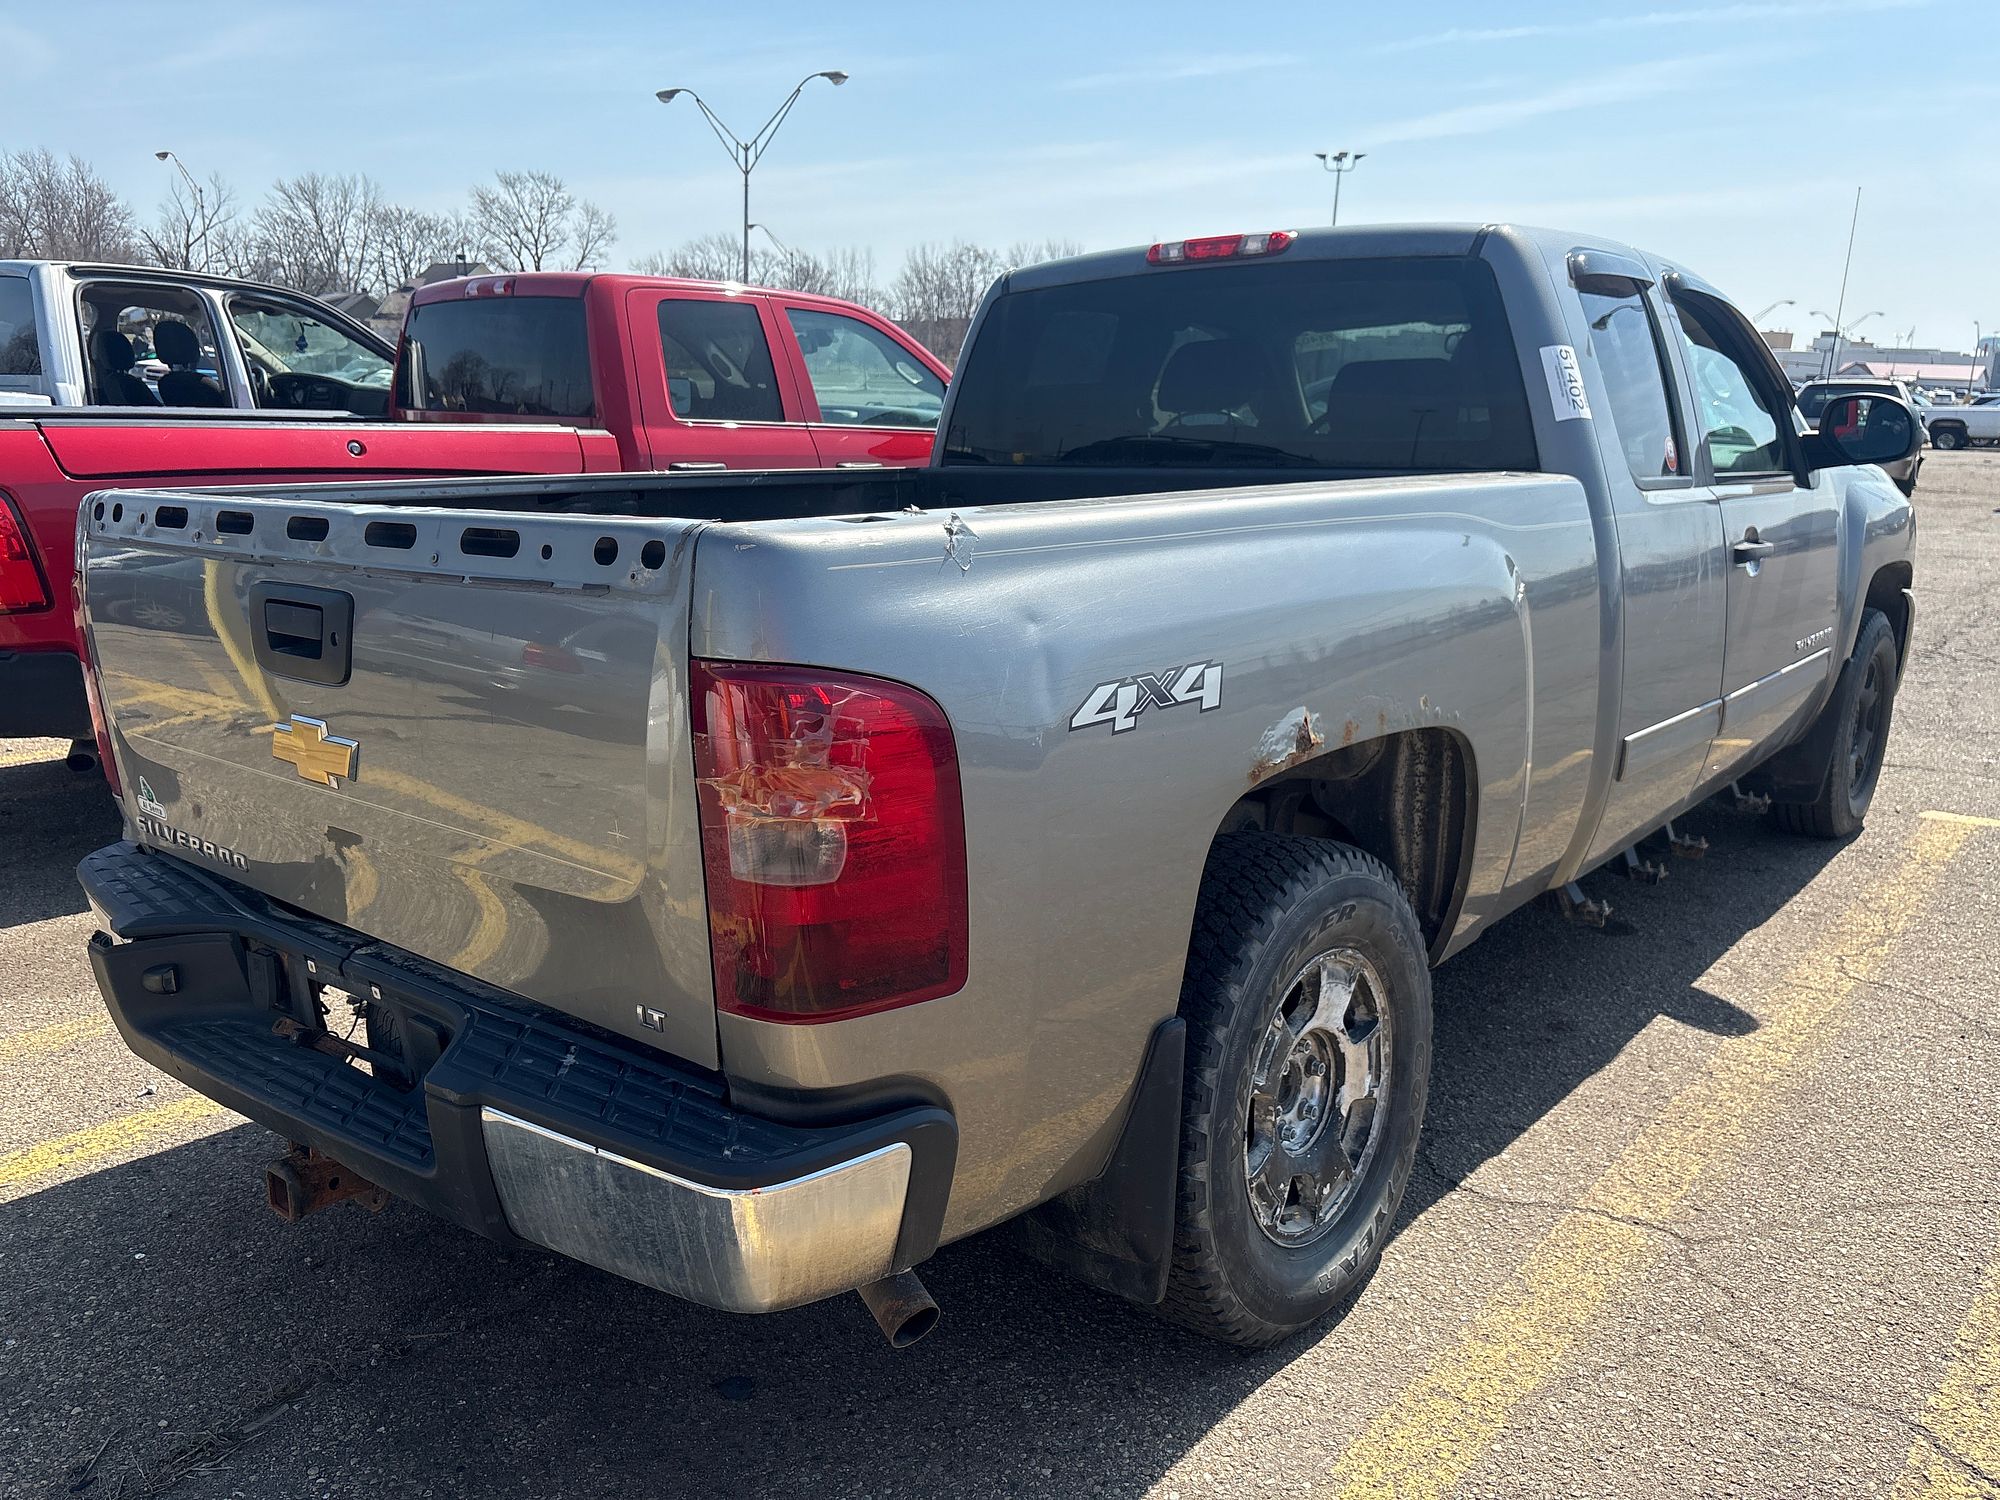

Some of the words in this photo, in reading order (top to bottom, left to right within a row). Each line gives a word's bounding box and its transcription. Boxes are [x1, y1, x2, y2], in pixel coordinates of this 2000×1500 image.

[1559, 348, 1585, 411] 51402
[136, 816, 250, 873] SILVERADO
[636, 1004, 668, 1032] LT
